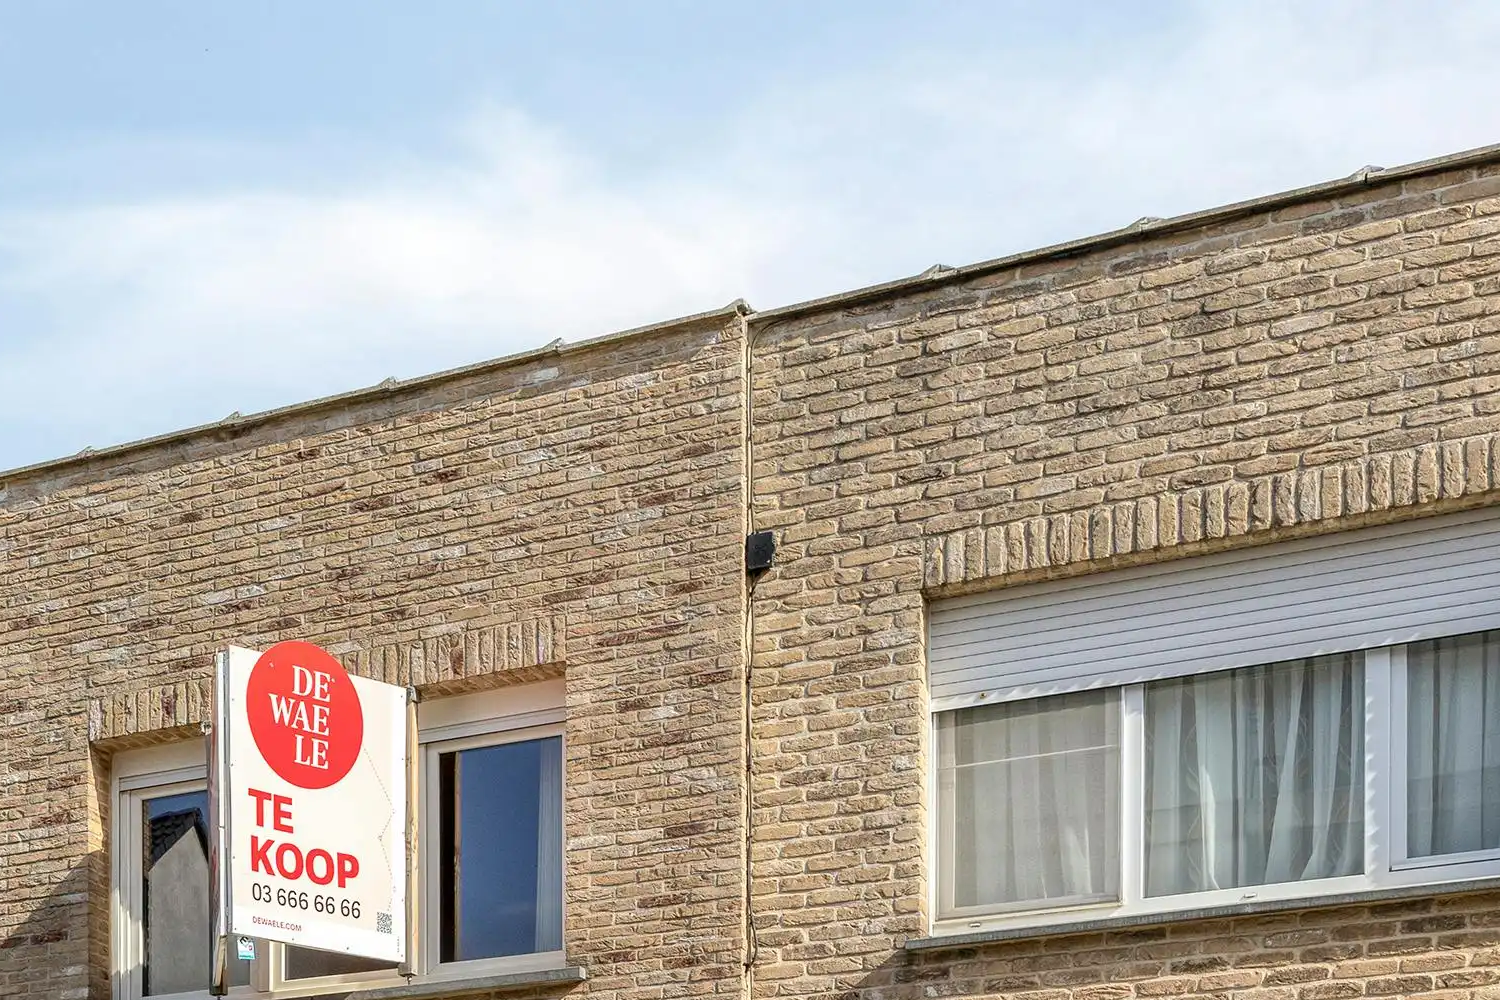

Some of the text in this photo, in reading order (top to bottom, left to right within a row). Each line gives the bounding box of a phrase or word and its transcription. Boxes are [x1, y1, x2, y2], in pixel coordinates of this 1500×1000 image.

[292, 664, 331, 703] DE
[268, 692, 330, 737] WAE
[294, 735, 329, 770] LE
[248, 788, 294, 834] TE
[250, 835, 360, 889] KOOP
[252, 883, 361, 919] 03 666 66 66
[252, 916, 302, 932] DEWAELE.COM
